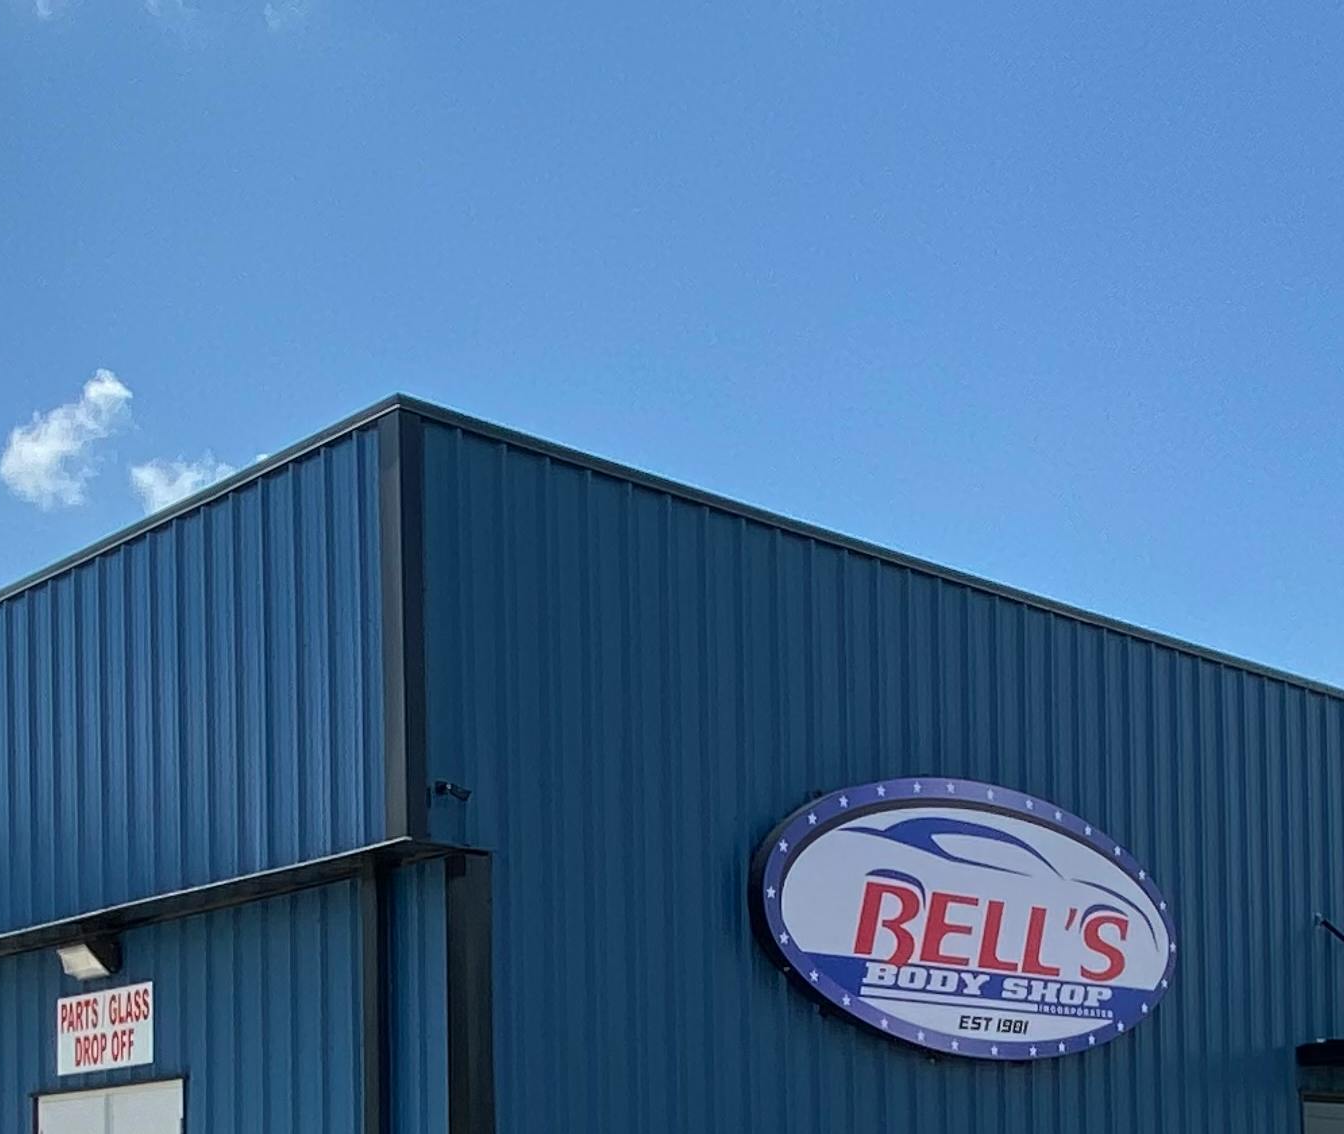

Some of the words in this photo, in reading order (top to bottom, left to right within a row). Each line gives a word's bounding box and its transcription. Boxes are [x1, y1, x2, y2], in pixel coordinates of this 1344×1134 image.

[854, 880, 1129, 982] BELL'S
[862, 962, 990, 996] BODY
[1001, 977, 1113, 1007] SHOP
[61, 998, 99, 1034] PARTS
[108, 988, 150, 1026] GLASS
[958, 1015, 993, 1032] EST
[75, 1033, 107, 1067] DROP
[111, 1028, 135, 1062] OFF
